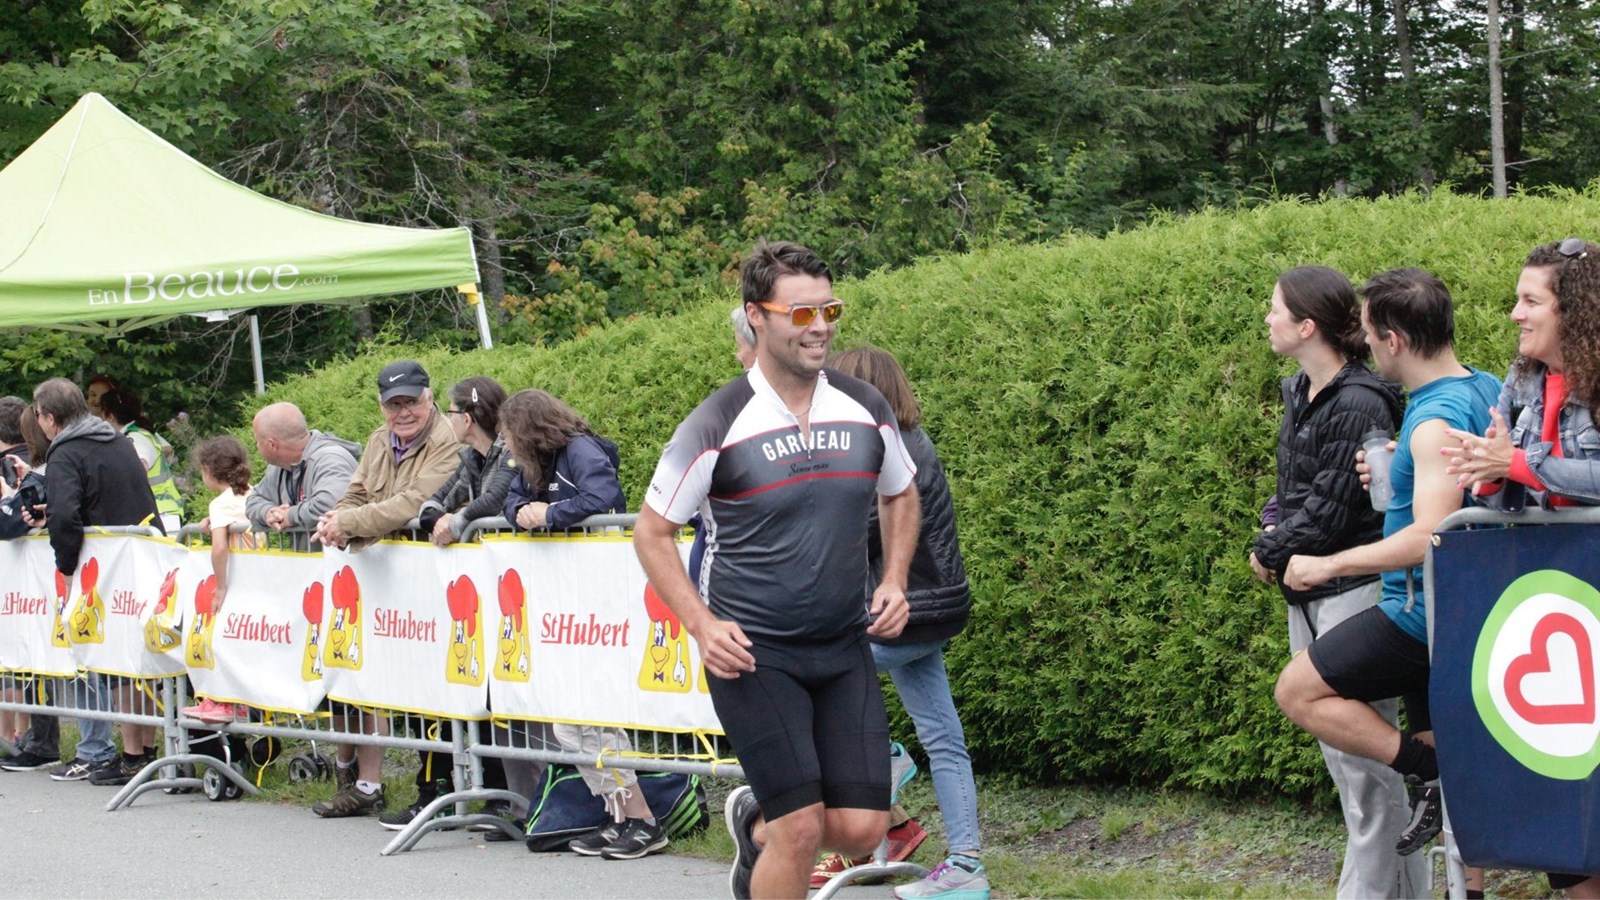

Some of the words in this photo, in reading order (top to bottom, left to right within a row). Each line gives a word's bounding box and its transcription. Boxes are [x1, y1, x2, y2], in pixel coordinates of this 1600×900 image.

[761, 430, 850, 462] GARNEAU
[223, 612, 292, 644] StHubert
[373, 607, 437, 643] StHubert
[541, 612, 630, 648] StHubert
